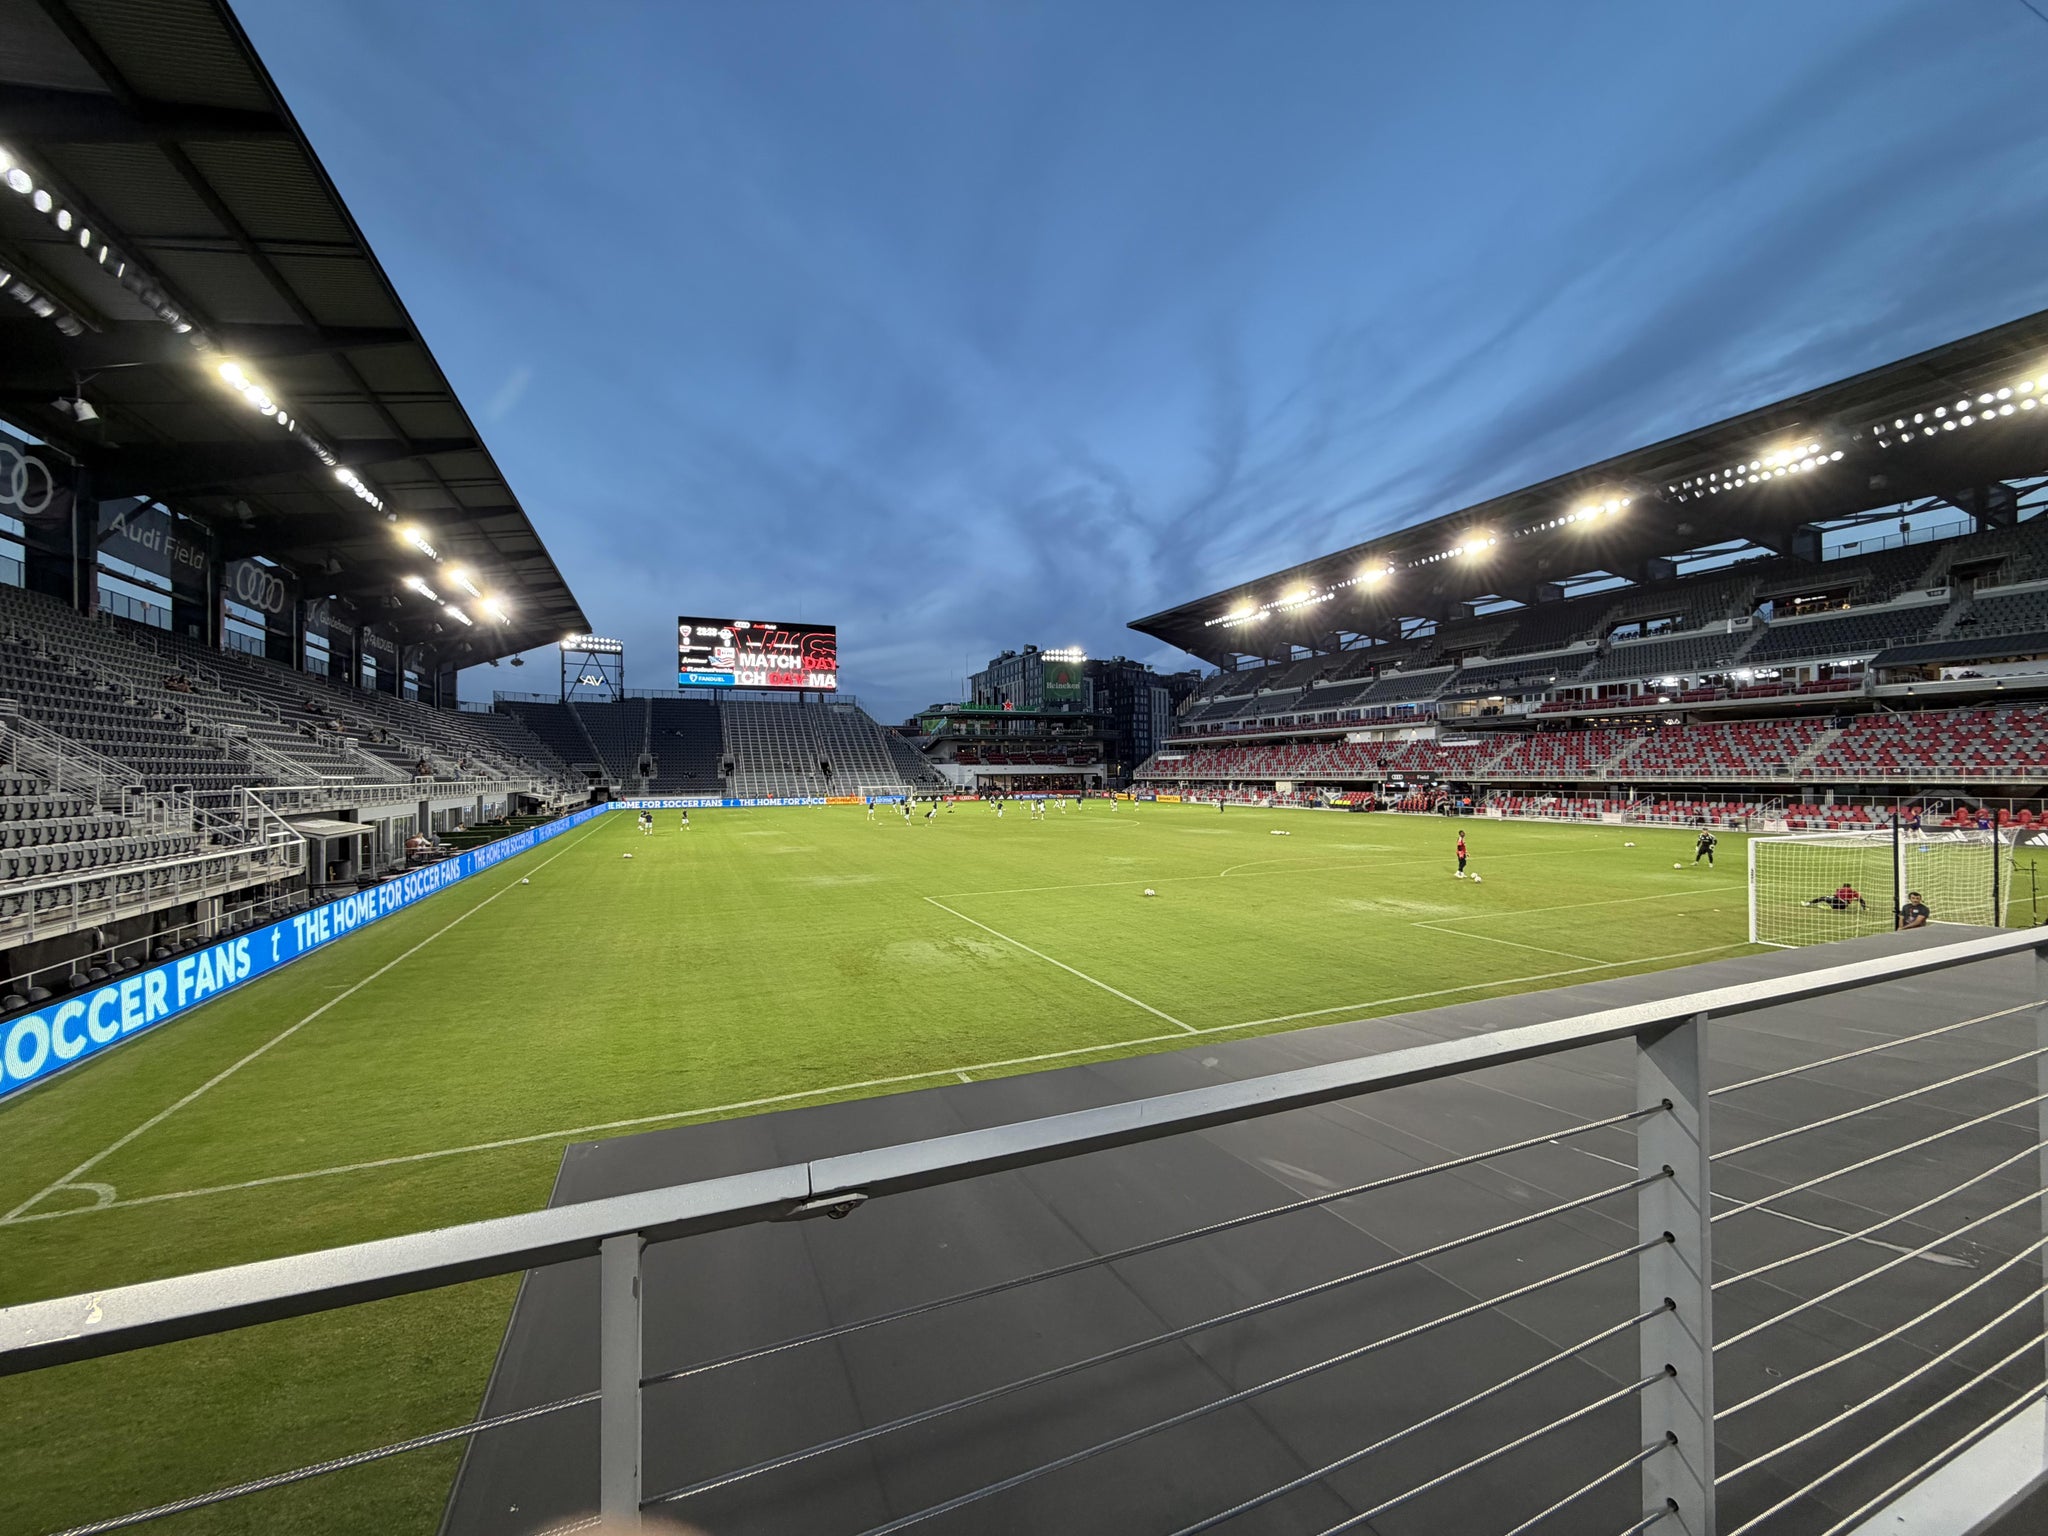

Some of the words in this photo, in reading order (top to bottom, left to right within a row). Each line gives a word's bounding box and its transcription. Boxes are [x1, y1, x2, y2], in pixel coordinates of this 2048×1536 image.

[109, 512, 161, 551] Audi
[164, 536, 204, 569] Field
[740, 653, 801, 668] MATCH
[769, 673, 806, 685] DAY
[809, 674, 835, 687] MA
[642, 800, 660, 809] FOR
[663, 800, 698, 808] SOCCER
[701, 799, 722, 807] FANS
[294, 906, 330, 951] THE
[333, 889, 377, 934] HOME
[379, 880, 403, 914] FOR
[404, 865, 440, 903] SOCCER
[441, 858, 460, 885] FANS
[0, 969, 169, 1083] OCCER
[177, 937, 251, 1006] FANS
